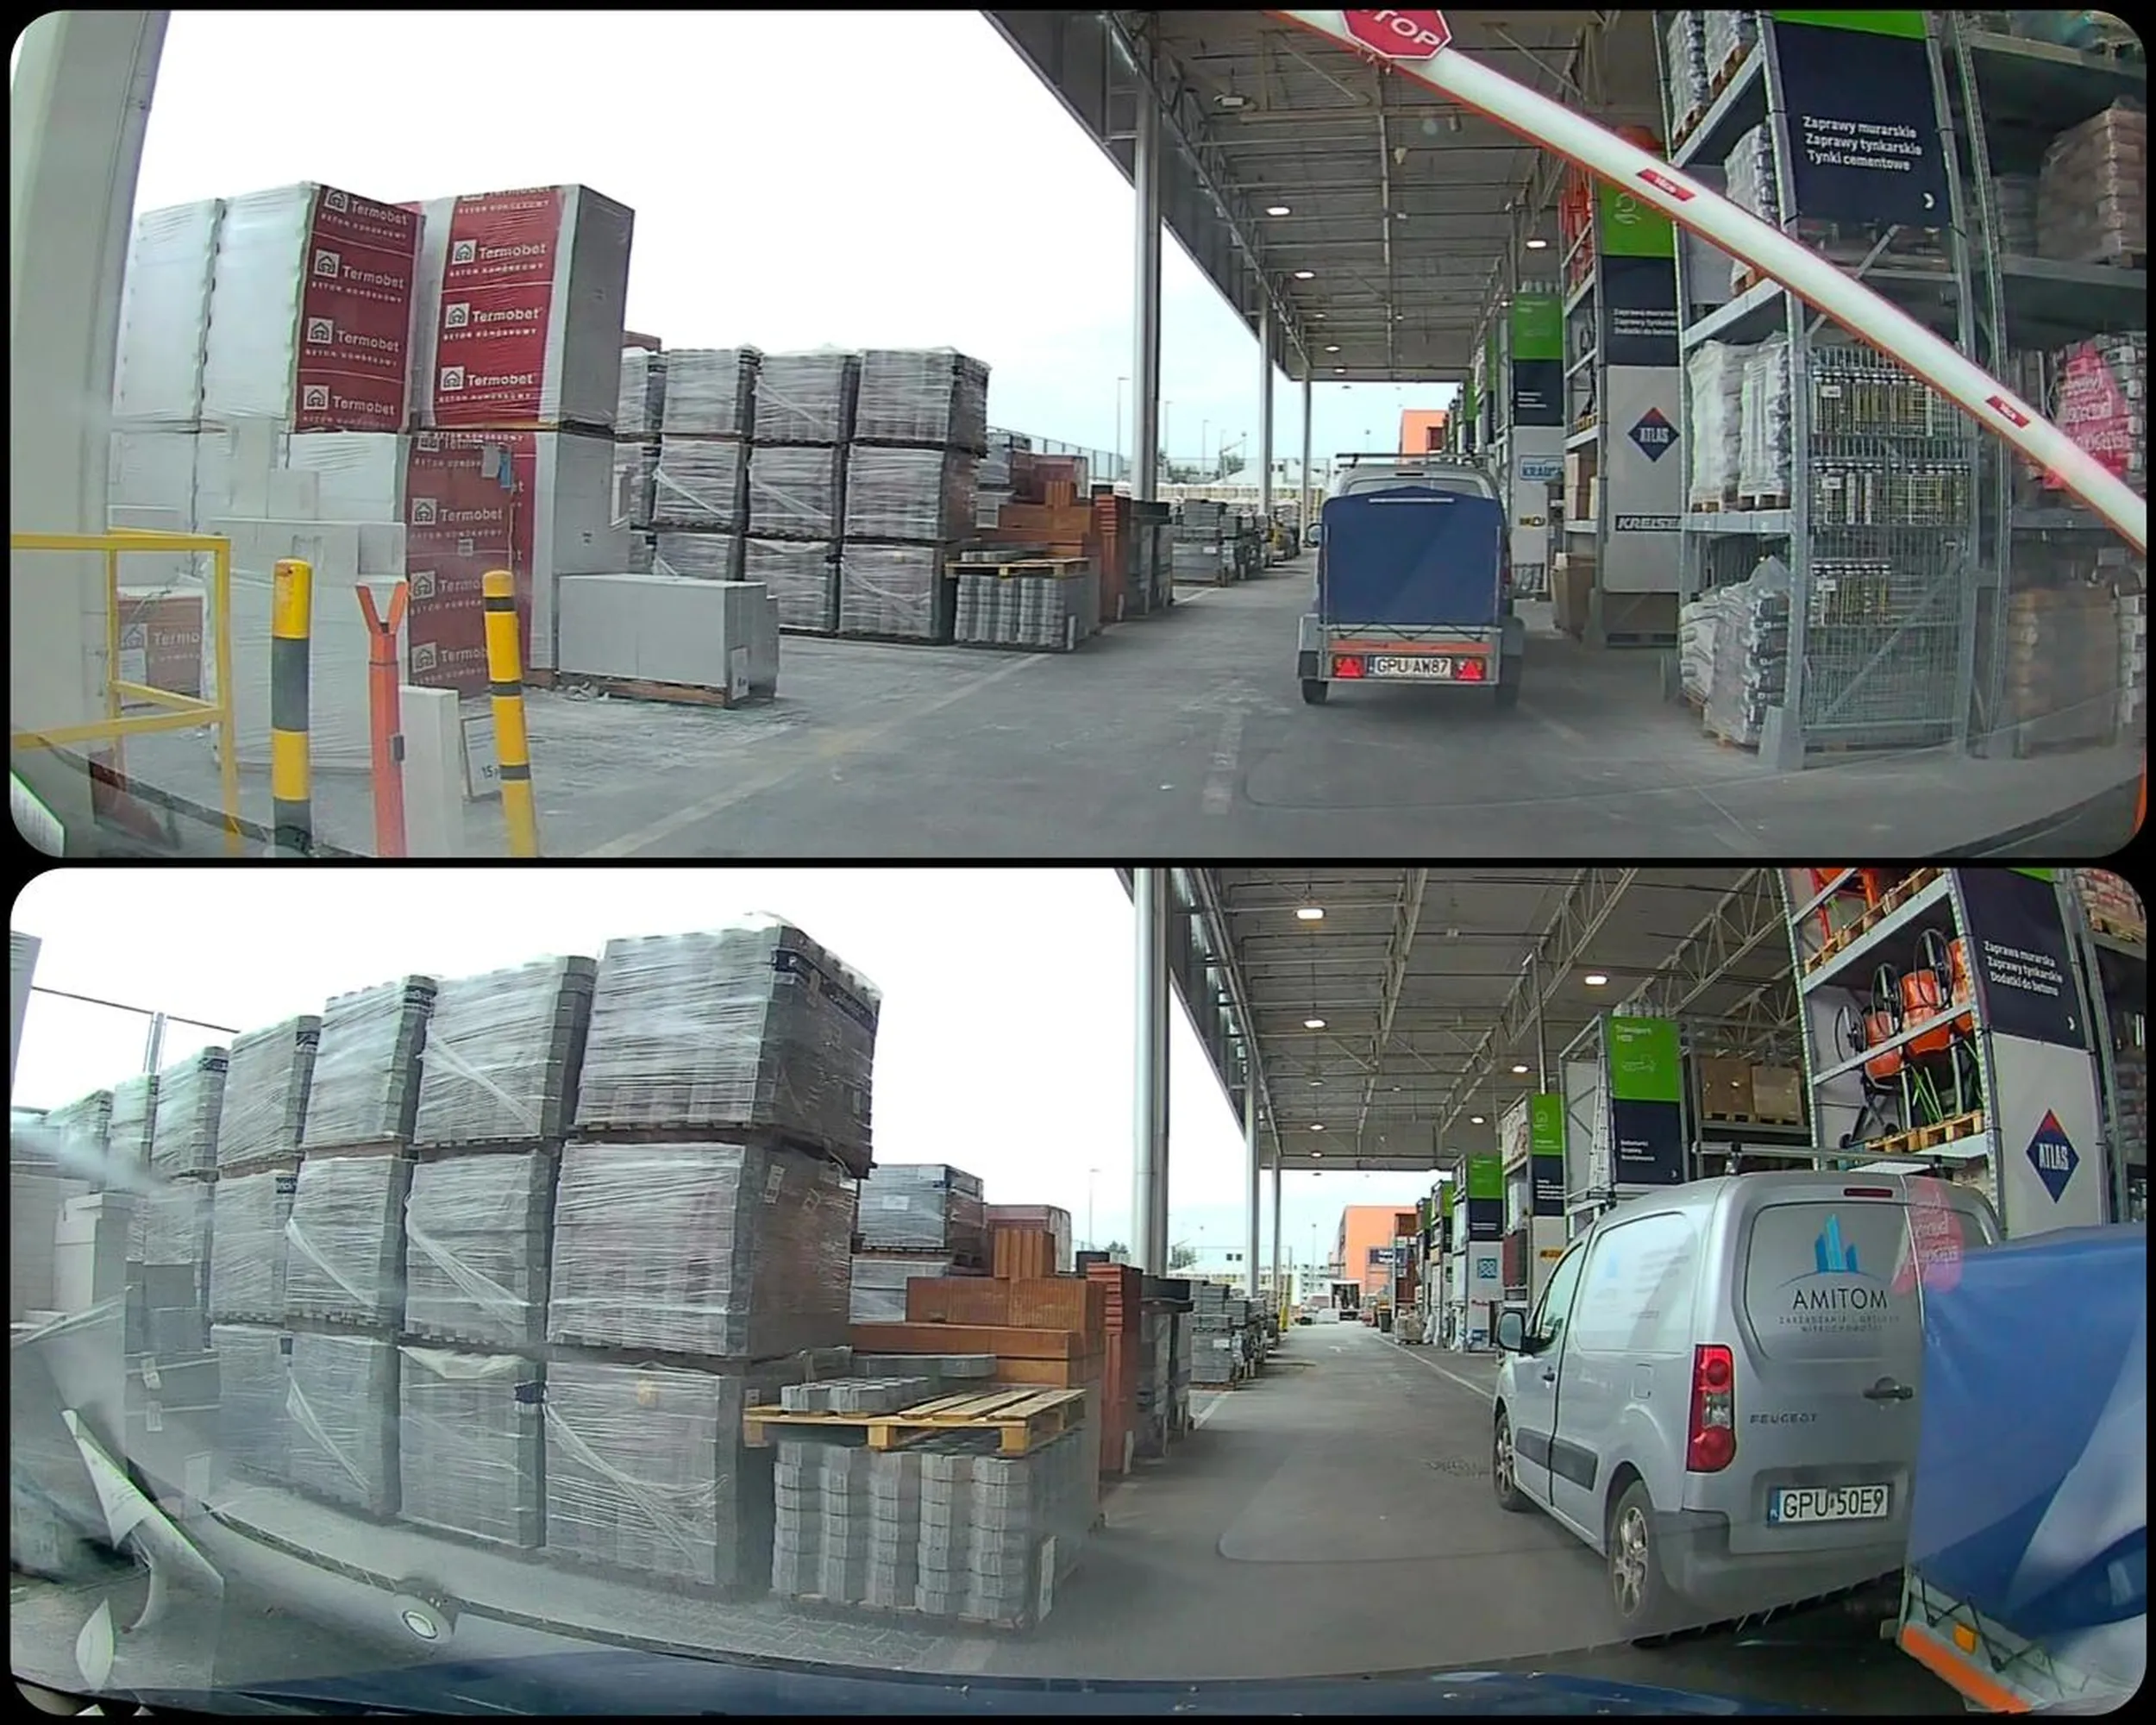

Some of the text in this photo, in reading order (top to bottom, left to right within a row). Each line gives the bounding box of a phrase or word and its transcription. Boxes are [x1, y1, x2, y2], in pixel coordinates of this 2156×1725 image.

[1360, 9, 1441, 46] TOP
[1802, 116, 1917, 139] Zaprawy murarskie
[1806, 133, 1922, 155] Zaprawy tynkarskie
[1808, 149, 1911, 171] Tynki cementowe
[351, 200, 409, 226] Termobet
[479, 243, 548, 260] Termobet
[342, 264, 405, 290] Termobet
[472, 308, 541, 323] Termobet
[336, 329, 399, 353] Termobet
[467, 373, 535, 386] Termobet
[332, 395, 396, 417] Termobet
[1639, 427, 1669, 443] ATLAS
[439, 507, 504, 523] Termobet
[1617, 517, 1681, 530] KREISE
[438, 578, 483, 593] Termo
[154, 631, 202, 647] Termo
[441, 648, 487, 663] Termo
[1377, 658, 1447, 674] GPU AW87
[2038, 1143, 2070, 1171] ATLAS
[1792, 1287, 1888, 1310] AMITOM
[1750, 1412, 1818, 1424] PEUGEOT
[1783, 1490, 1829, 1519] GPU
[1836, 1487, 1885, 1516] 50E9
